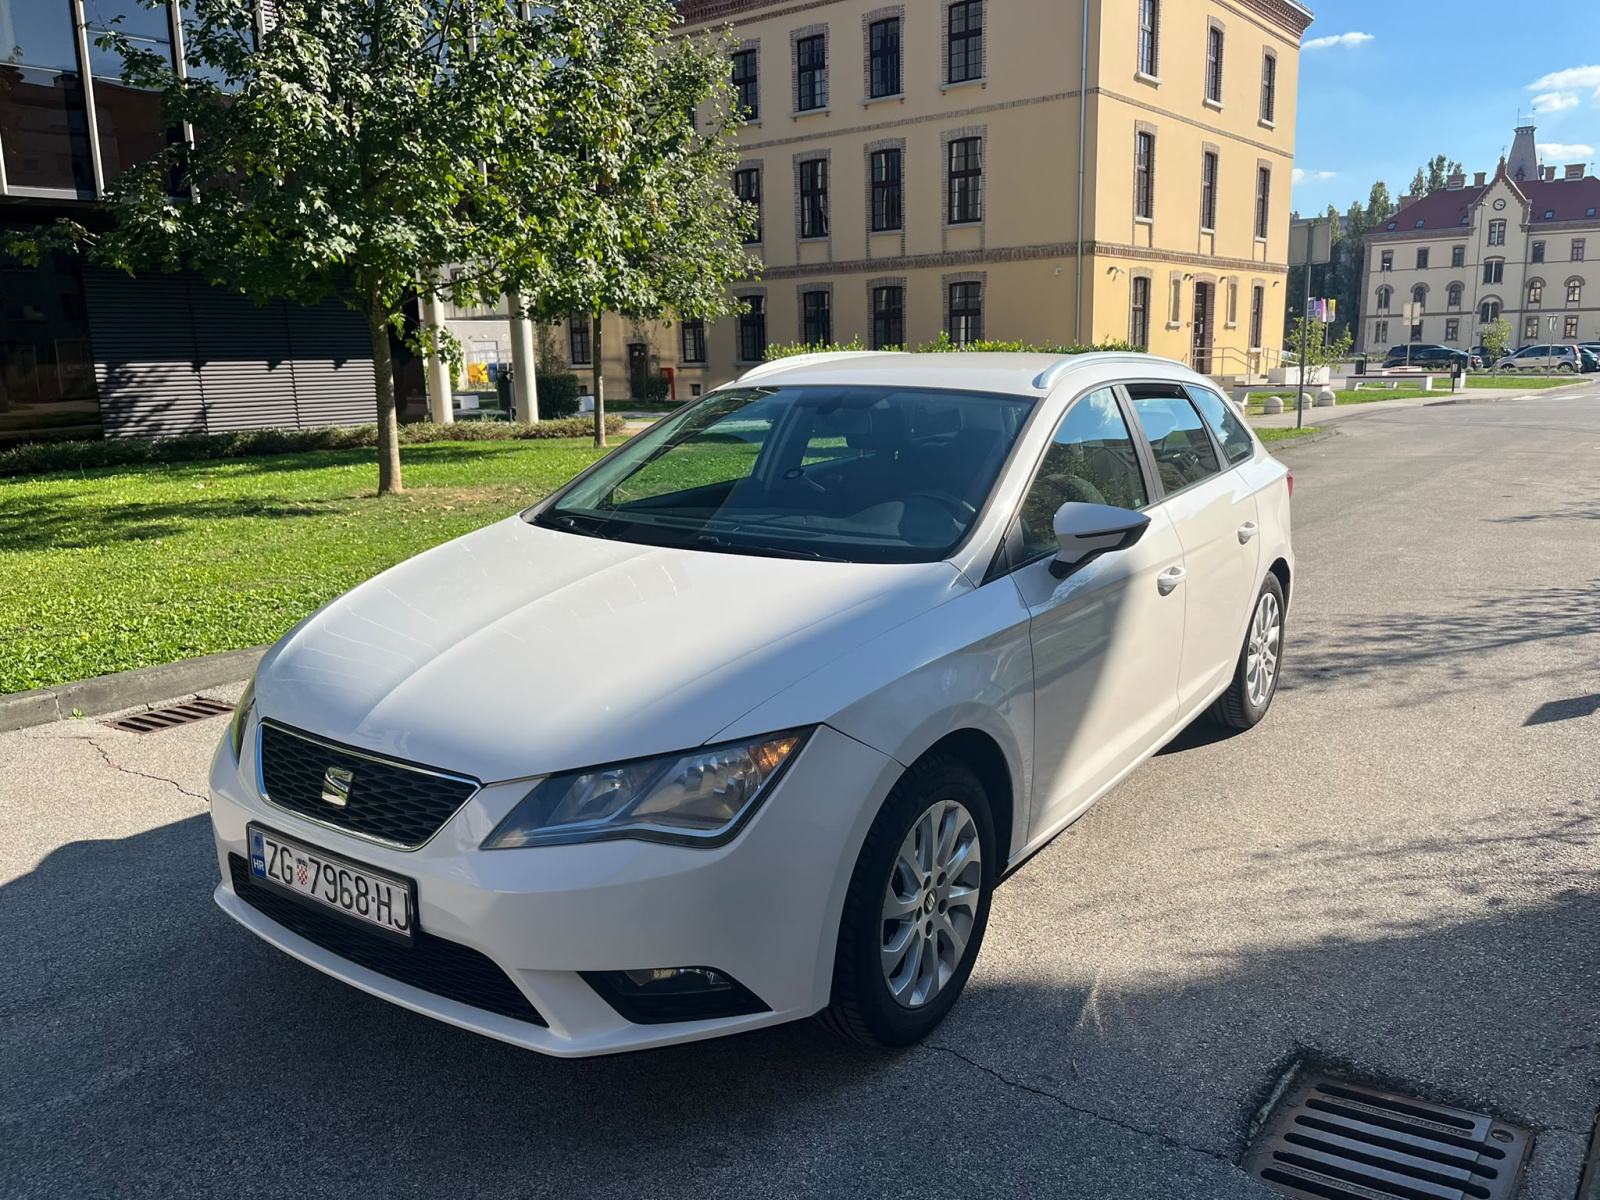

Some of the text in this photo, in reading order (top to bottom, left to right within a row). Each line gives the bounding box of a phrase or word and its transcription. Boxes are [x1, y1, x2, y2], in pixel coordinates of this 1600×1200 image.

[253, 858, 265, 871] HR
[265, 840, 410, 931] ZG 7968-HJ
